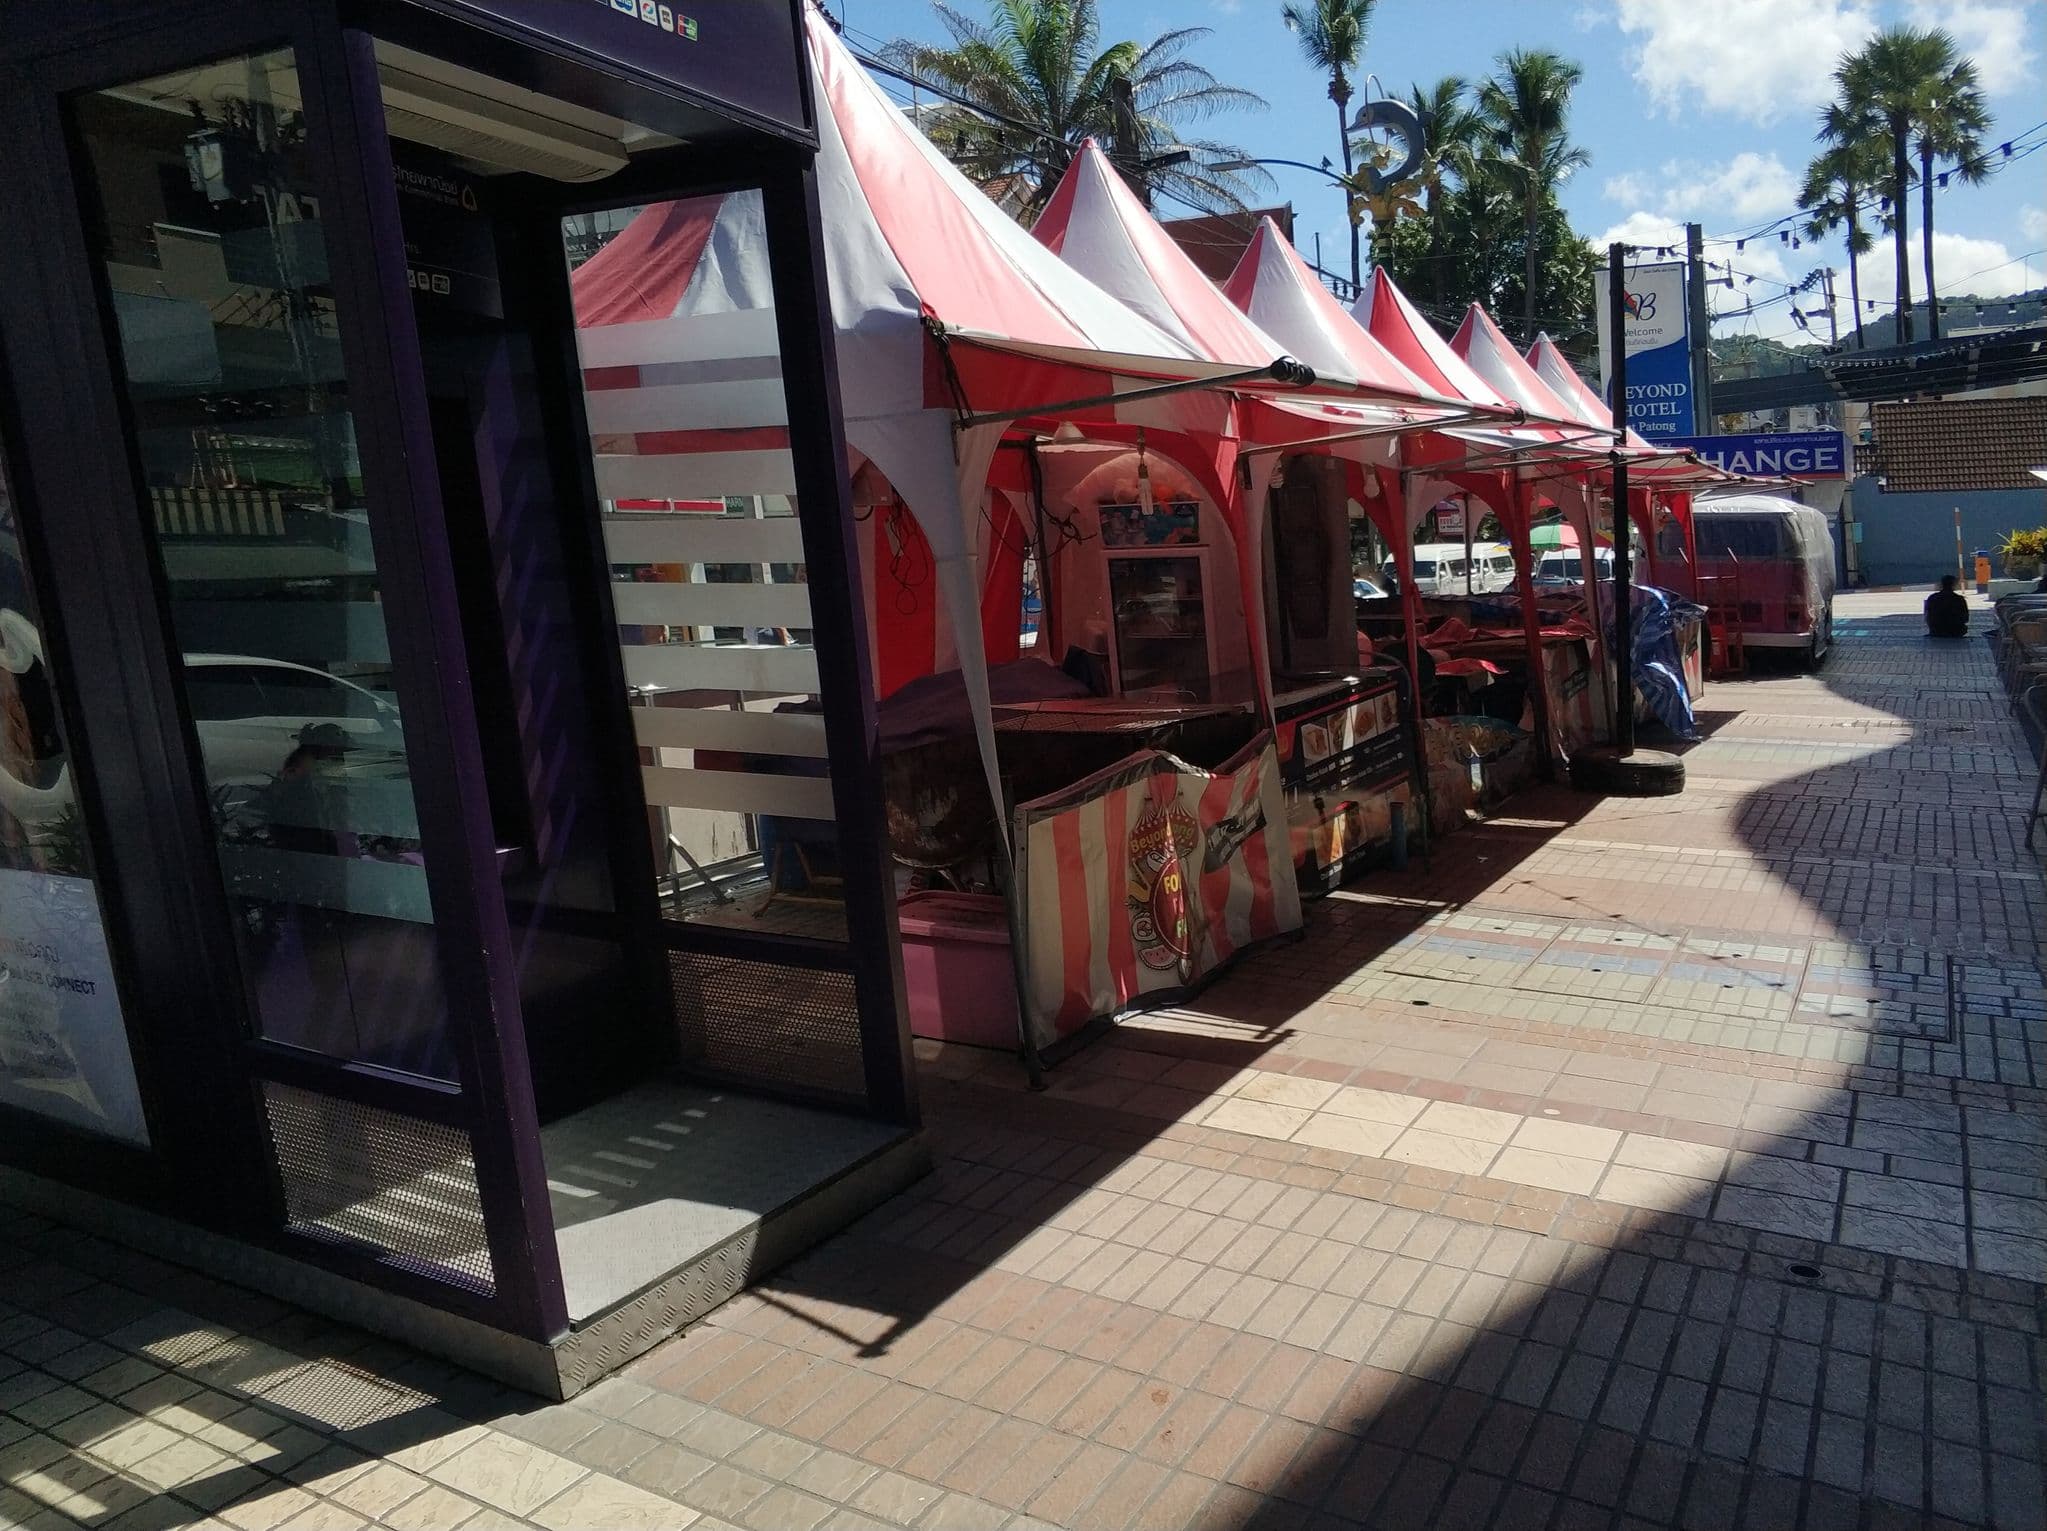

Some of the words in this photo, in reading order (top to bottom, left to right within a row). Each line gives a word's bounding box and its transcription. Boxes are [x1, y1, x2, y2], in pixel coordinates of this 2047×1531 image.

[1625, 383, 1687, 400] EYOND
[1639, 421, 1677, 433] Patong
[1700, 446, 1839, 473] HANGE
